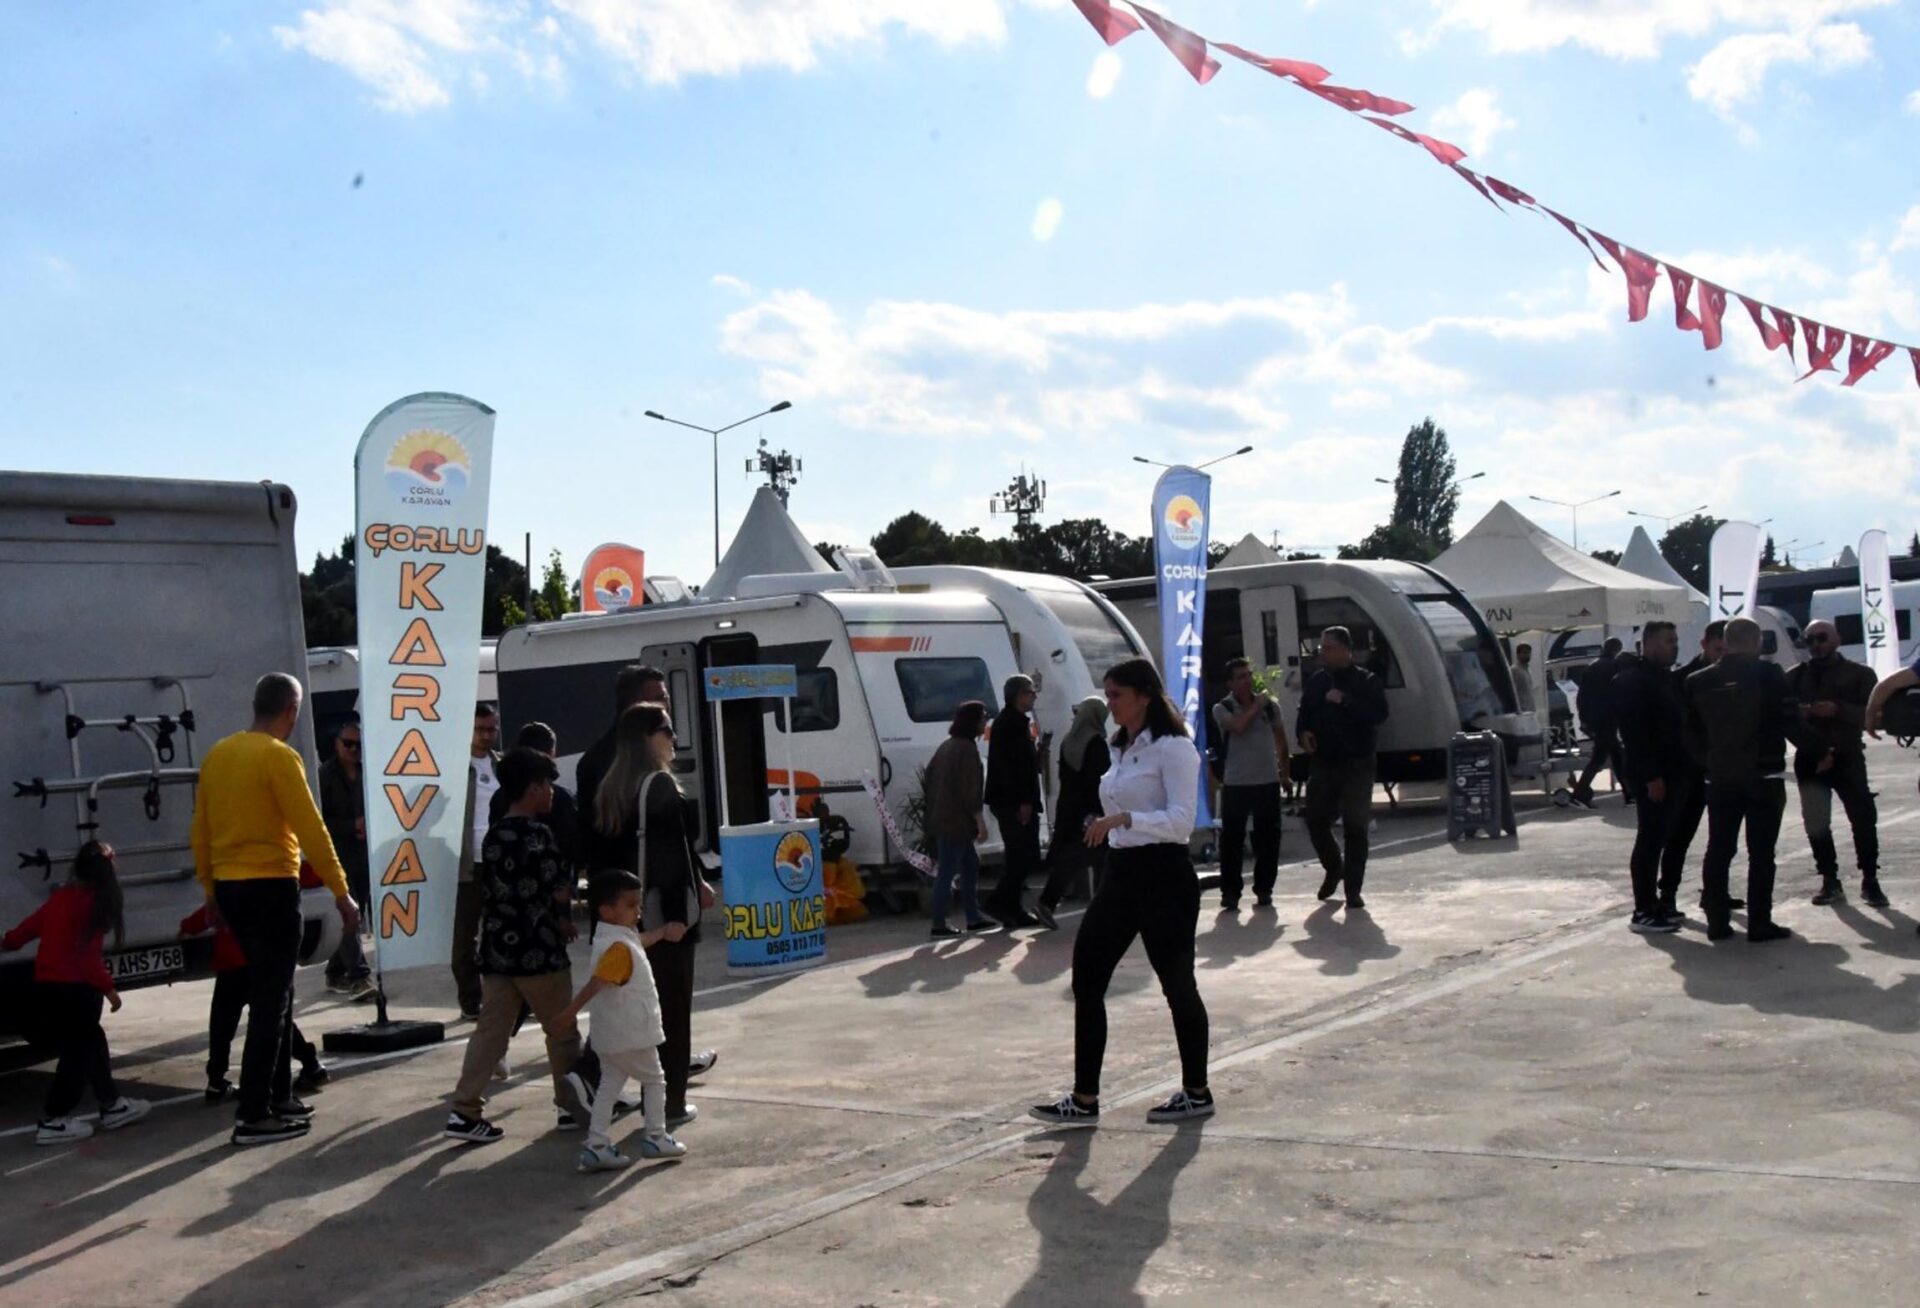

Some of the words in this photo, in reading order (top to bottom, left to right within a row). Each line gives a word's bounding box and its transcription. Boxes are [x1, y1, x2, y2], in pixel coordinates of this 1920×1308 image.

[401, 496, 452, 506] KARAVAN
[364, 523, 484, 558] ÇORLU
[1865, 583, 1888, 649] NEXT
[380, 561, 447, 939] KARAVAN
[722, 900, 784, 941] ORLU
[790, 894, 827, 935] KAR
[118, 954, 150, 977] AHS
[151, 947, 182, 971] 768
